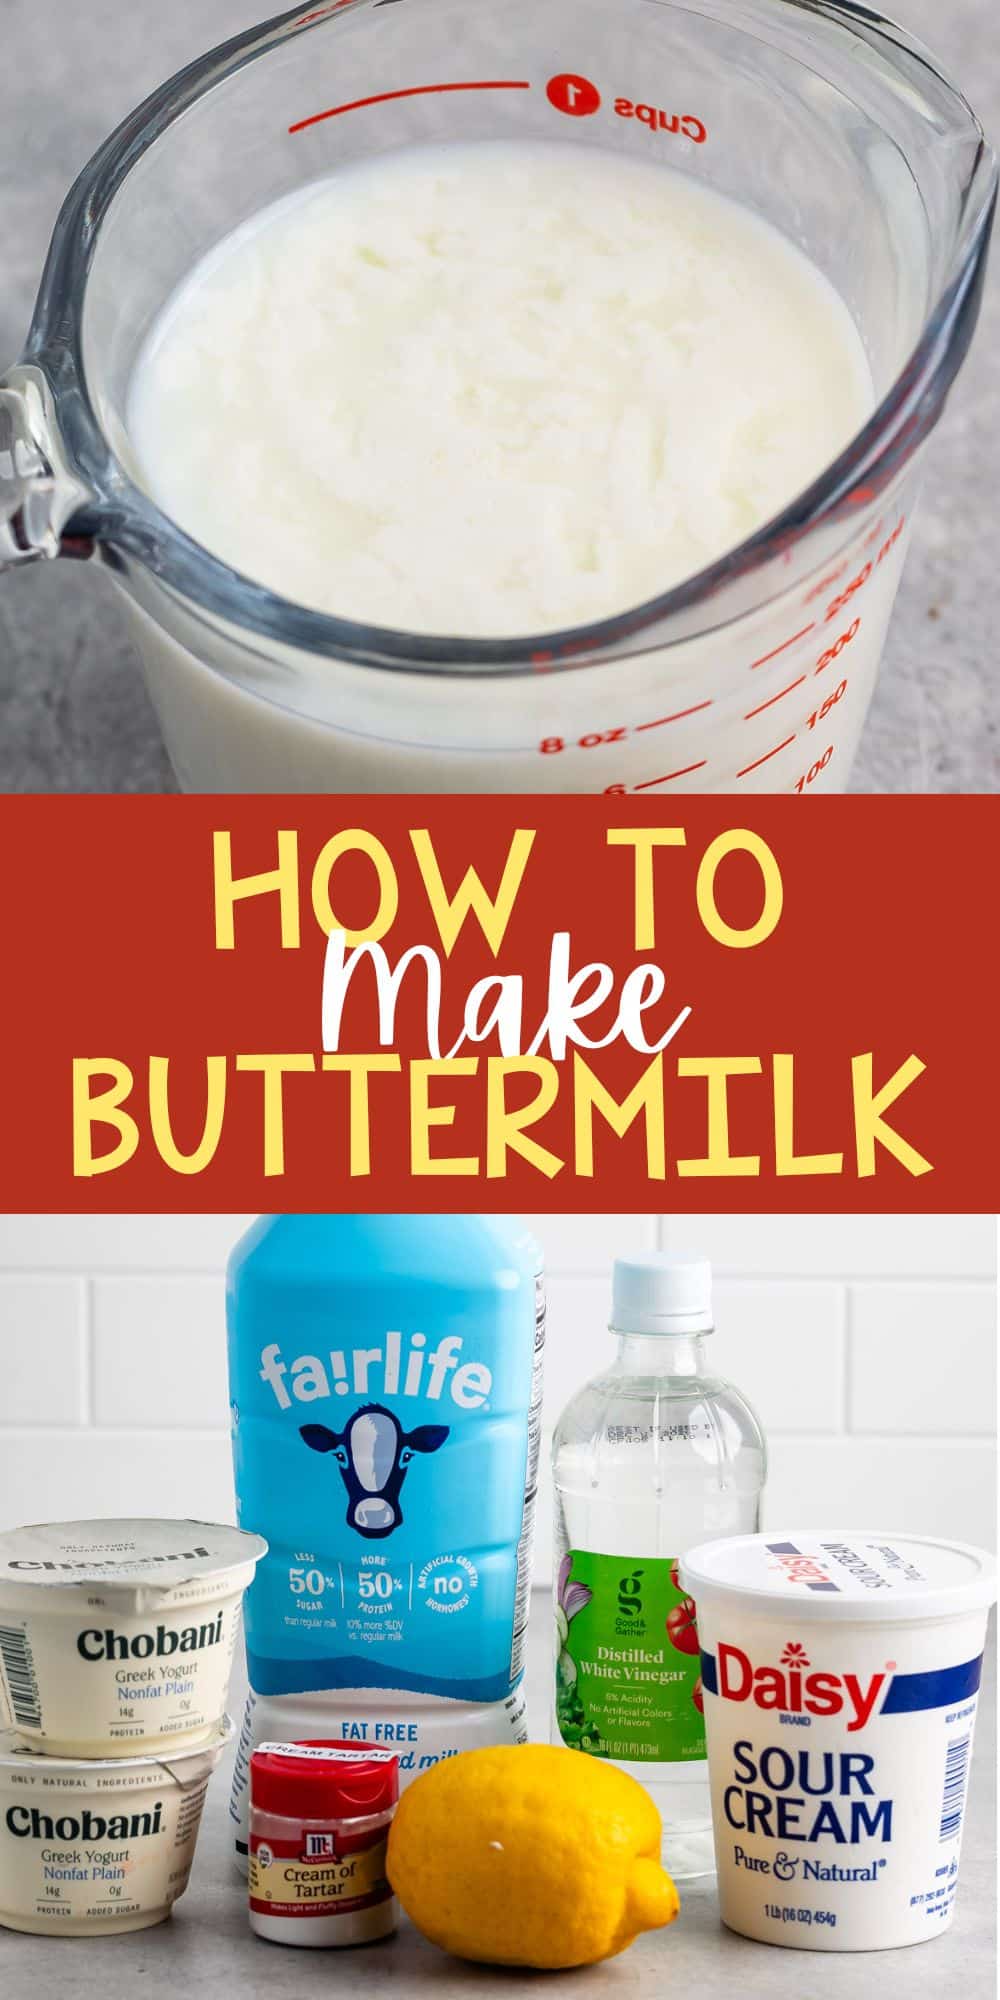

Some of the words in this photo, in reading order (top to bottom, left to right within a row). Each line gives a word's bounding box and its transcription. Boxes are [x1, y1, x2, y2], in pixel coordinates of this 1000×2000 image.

[813, 616, 861, 677] 200
[805, 679, 848, 732] 150
[538, 736, 565, 755] 8
[577, 727, 629, 750] oz
[794, 745, 834, 794] 100
[294, 1552, 316, 1563] LESS
[288, 1567, 336, 1596] 50%
[417, 1554, 455, 1590] ARTIFICIAL
[357, 1571, 404, 1599] 50%
[433, 1575, 464, 1596] no
[295, 1598, 325, 1611] SUGAR
[357, 1601, 394, 1615] PROTEIN
[76, 1610, 224, 1663] Chobani
[615, 1627, 648, 1638] Gather
[597, 1646, 665, 1665] Distilled
[114, 1669, 157, 1685] Greek
[159, 1661, 199, 1682] Yogurt
[580, 1660, 622, 1680] White
[625, 1666, 687, 1685] Vinegar
[117, 1684, 163, 1701] Nonfat
[164, 1681, 195, 1697] Plain
[717, 1640, 887, 1732] Daisy
[620, 1694, 653, 1705] Acidity
[119, 1707, 135, 1719] 14g
[589, 1703, 601, 1713] No
[602, 1705, 640, 1717] Artificial
[641, 1708, 672, 1719] Colors
[779, 1713, 812, 1728] BRAND
[618, 1716, 651, 1728] Flavors
[109, 1727, 146, 1738] PROTEIN
[341, 1722, 367, 1741] FAT
[374, 1723, 419, 1742] FREE
[733, 1739, 876, 1798] SOUR
[10, 1774, 37, 1786] ONLY
[42, 1776, 88, 1788] NATURAL
[96, 1773, 164, 1788] INGREDIENTS
[6, 1801, 163, 1842] Chobani
[723, 1785, 894, 1845] CREAM
[40, 1849, 81, 1865] Greek
[85, 1848, 130, 1867] Yogurt
[733, 1845, 771, 1875] Pure
[772, 1851, 801, 1882] &
[43, 1866, 89, 1881] Nonfat
[92, 1866, 126, 1881] Plain
[283, 1867, 336, 1882] Cream
[339, 1861, 357, 1879] of
[44, 1886, 61, 1898] 14g
[108, 1885, 122, 1898] 0g
[294, 1882, 345, 1898] Tartar
[36, 1906, 72, 1916] PROTEIN
[86, 1907, 114, 1917] ADDED
[115, 1903, 141, 1916] SUGAR
